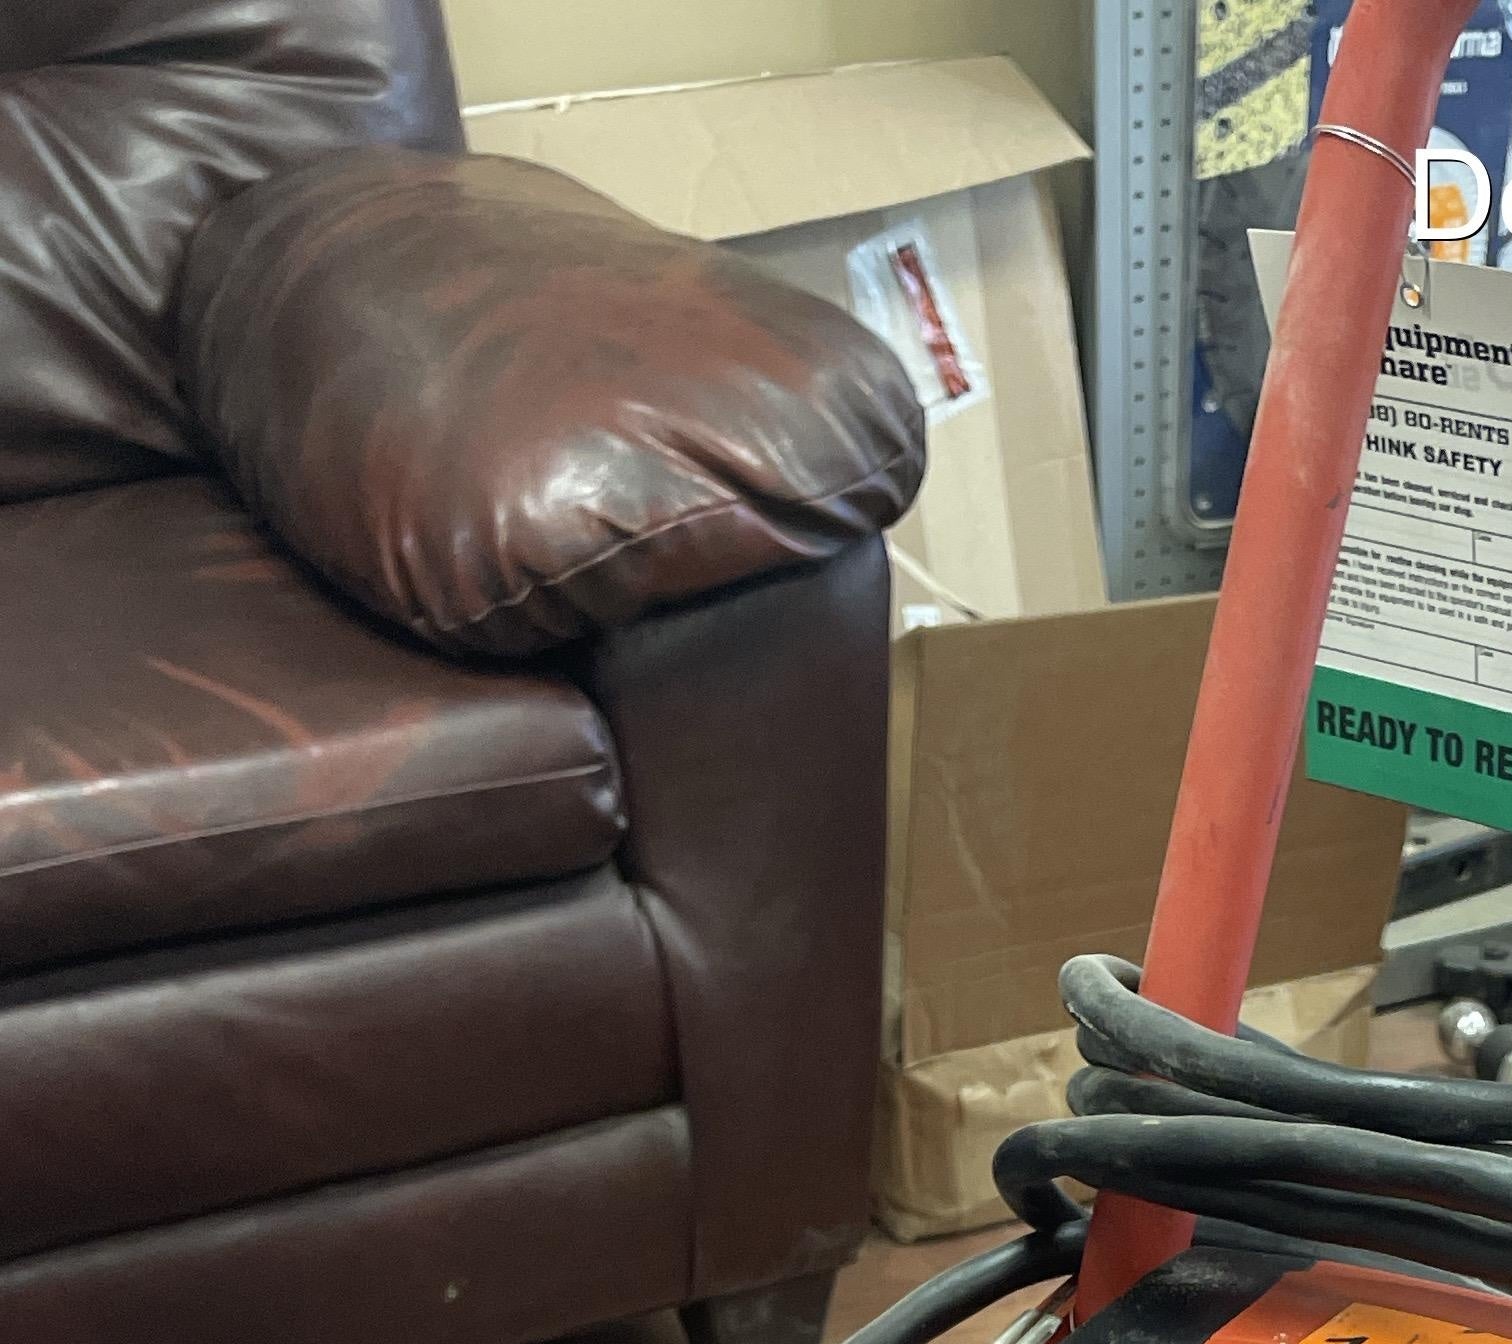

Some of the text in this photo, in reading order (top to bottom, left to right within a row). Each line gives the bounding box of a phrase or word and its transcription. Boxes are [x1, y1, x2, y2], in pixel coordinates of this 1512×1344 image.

[1380, 350, 1448, 386] hare
[1366, 434, 1503, 476] HINK SAFETY
[1316, 700, 1419, 755] READY
[1424, 726, 1464, 768] TO
